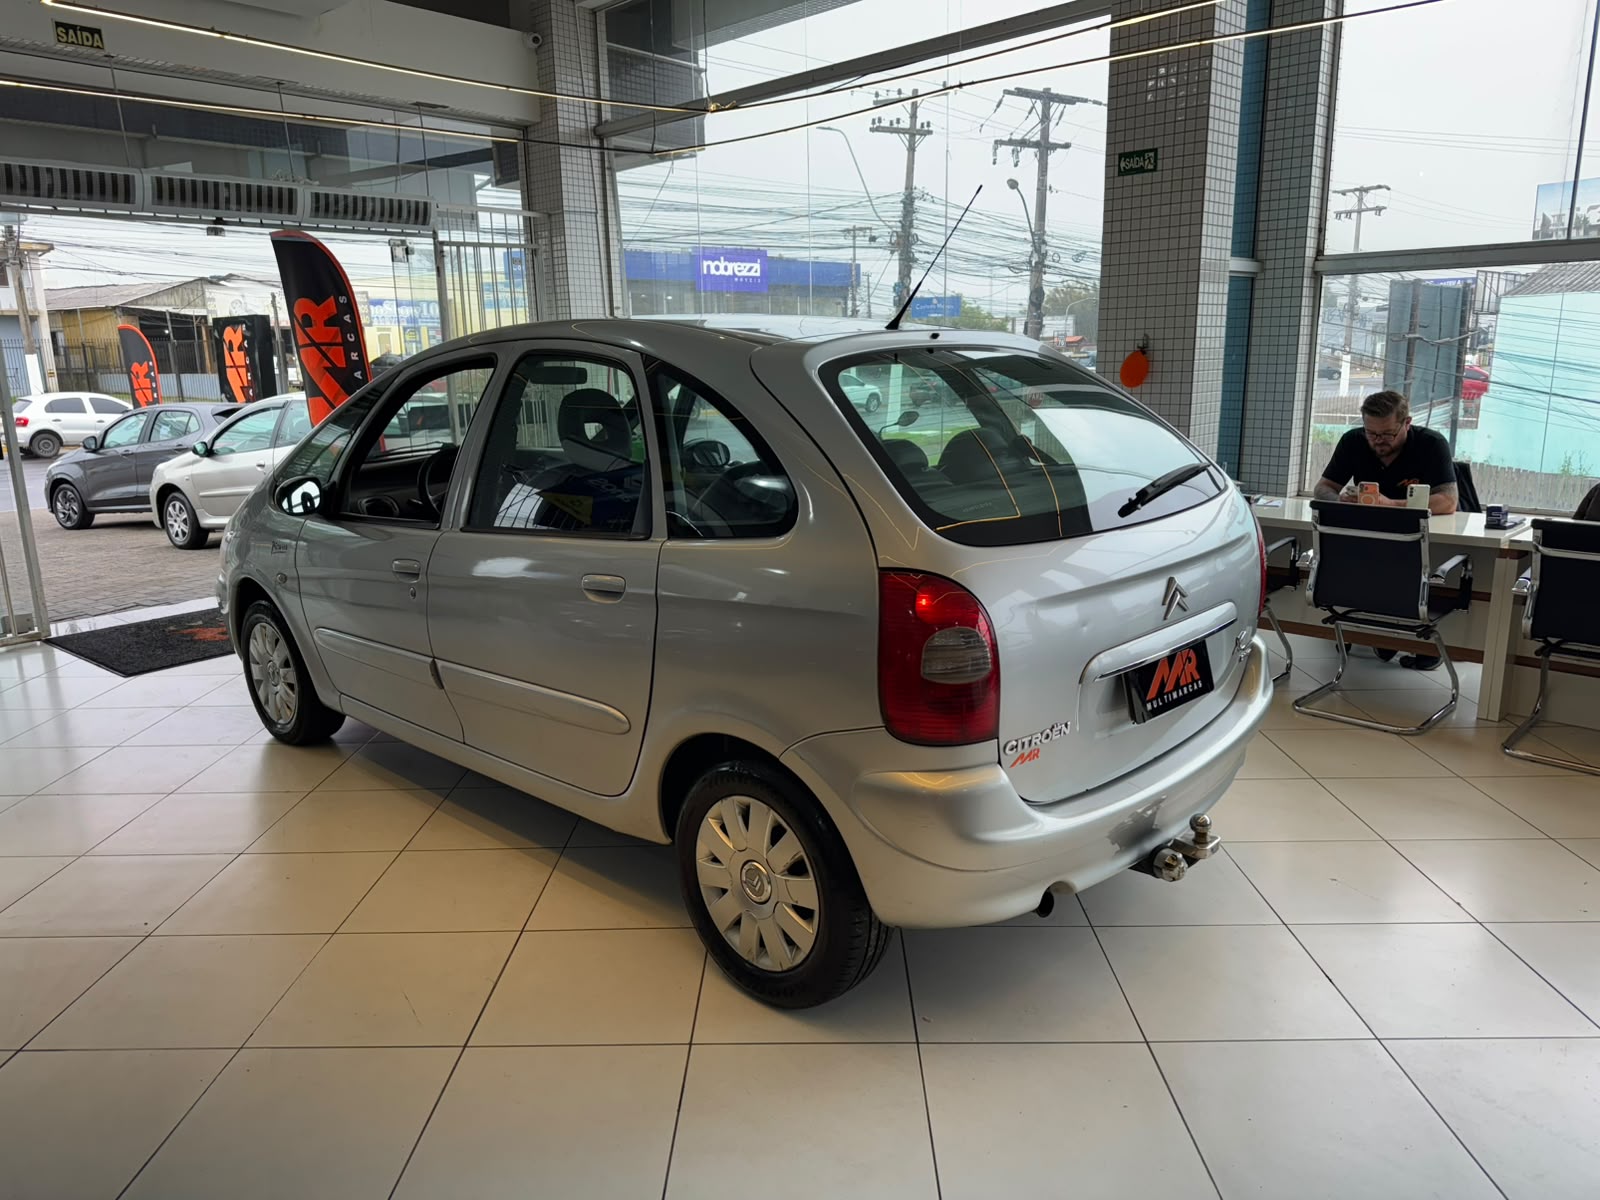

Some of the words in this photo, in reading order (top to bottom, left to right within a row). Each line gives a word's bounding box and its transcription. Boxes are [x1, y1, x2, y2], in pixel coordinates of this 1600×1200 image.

[56, 25, 103, 48] SAÍDA
[1125, 155, 1145, 170] SAÍDA
[703, 256, 761, 277] nobrezzi
[1145, 648, 1201, 701] MR
[1146, 680, 1203, 712] MULTIMARCAS
[1004, 720, 1071, 756] CITROËN
